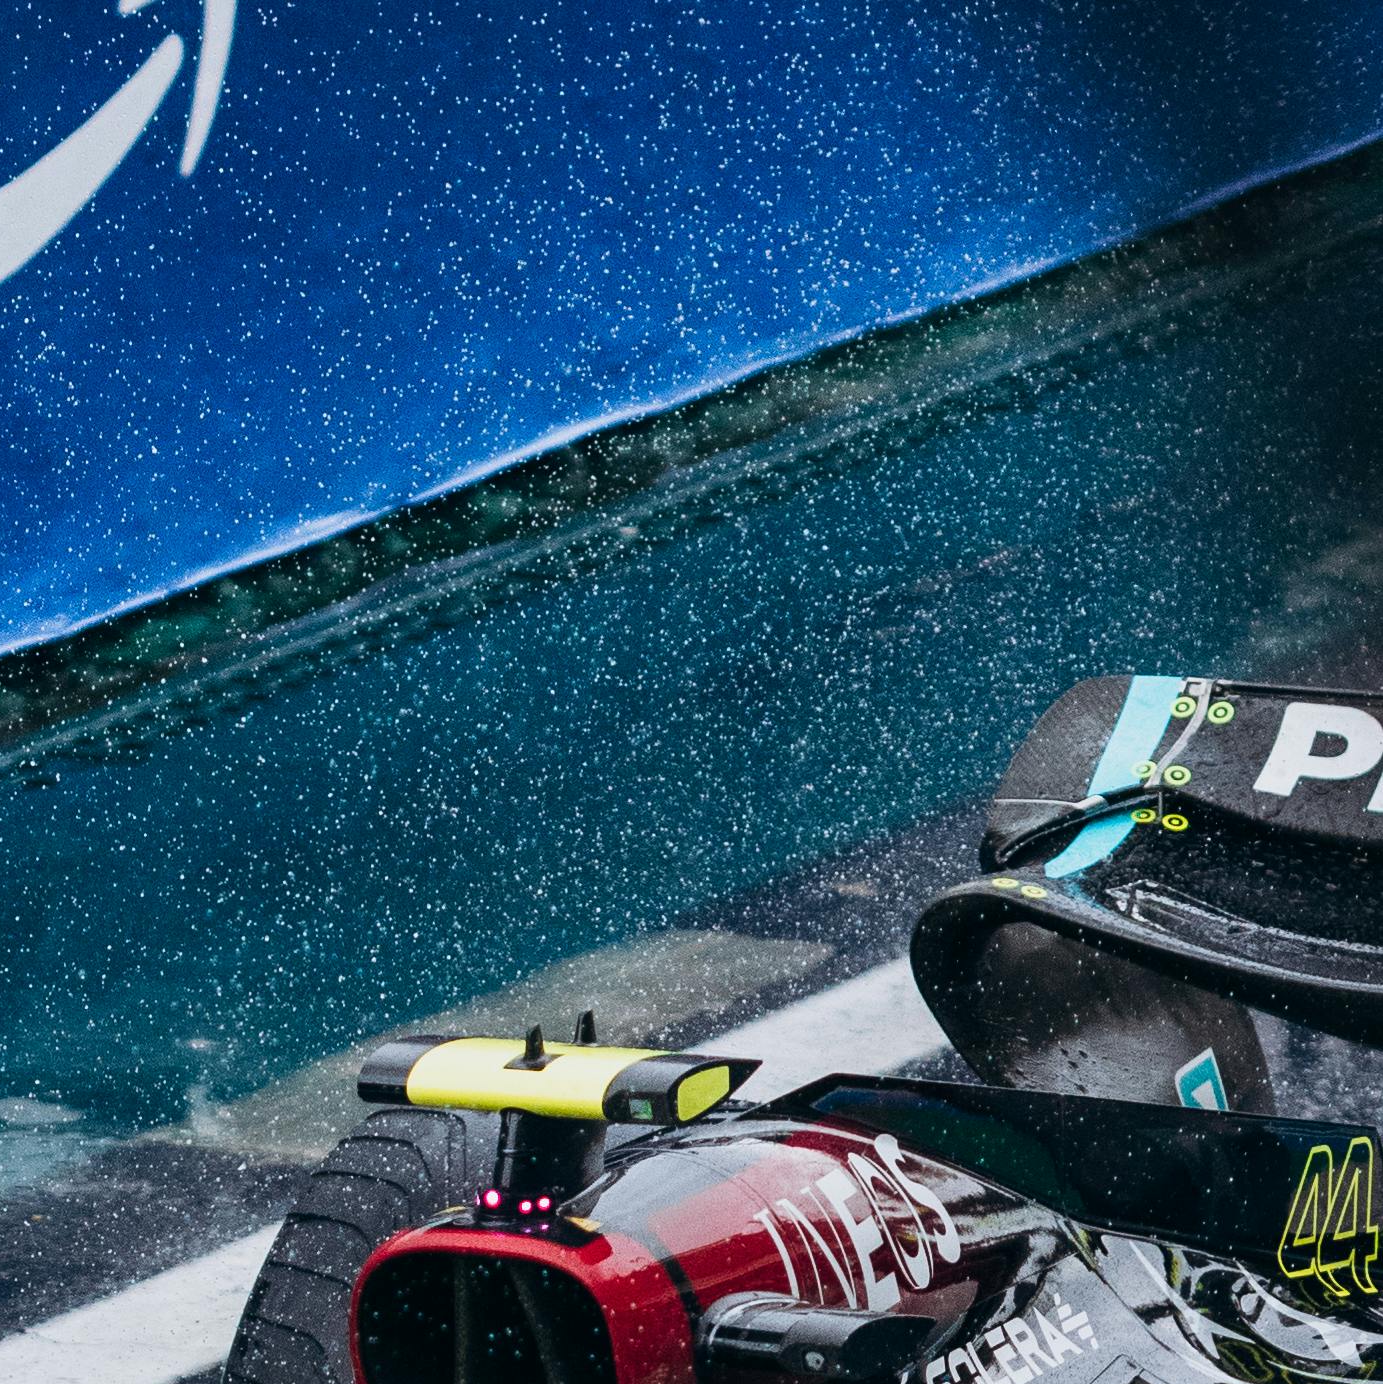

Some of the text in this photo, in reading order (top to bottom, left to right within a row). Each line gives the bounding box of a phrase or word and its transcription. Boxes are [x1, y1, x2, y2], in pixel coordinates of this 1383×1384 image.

[1253, 702, 1383, 812] P
[753, 1134, 961, 1313] INEOS
[1278, 1136, 1379, 1297] 44
